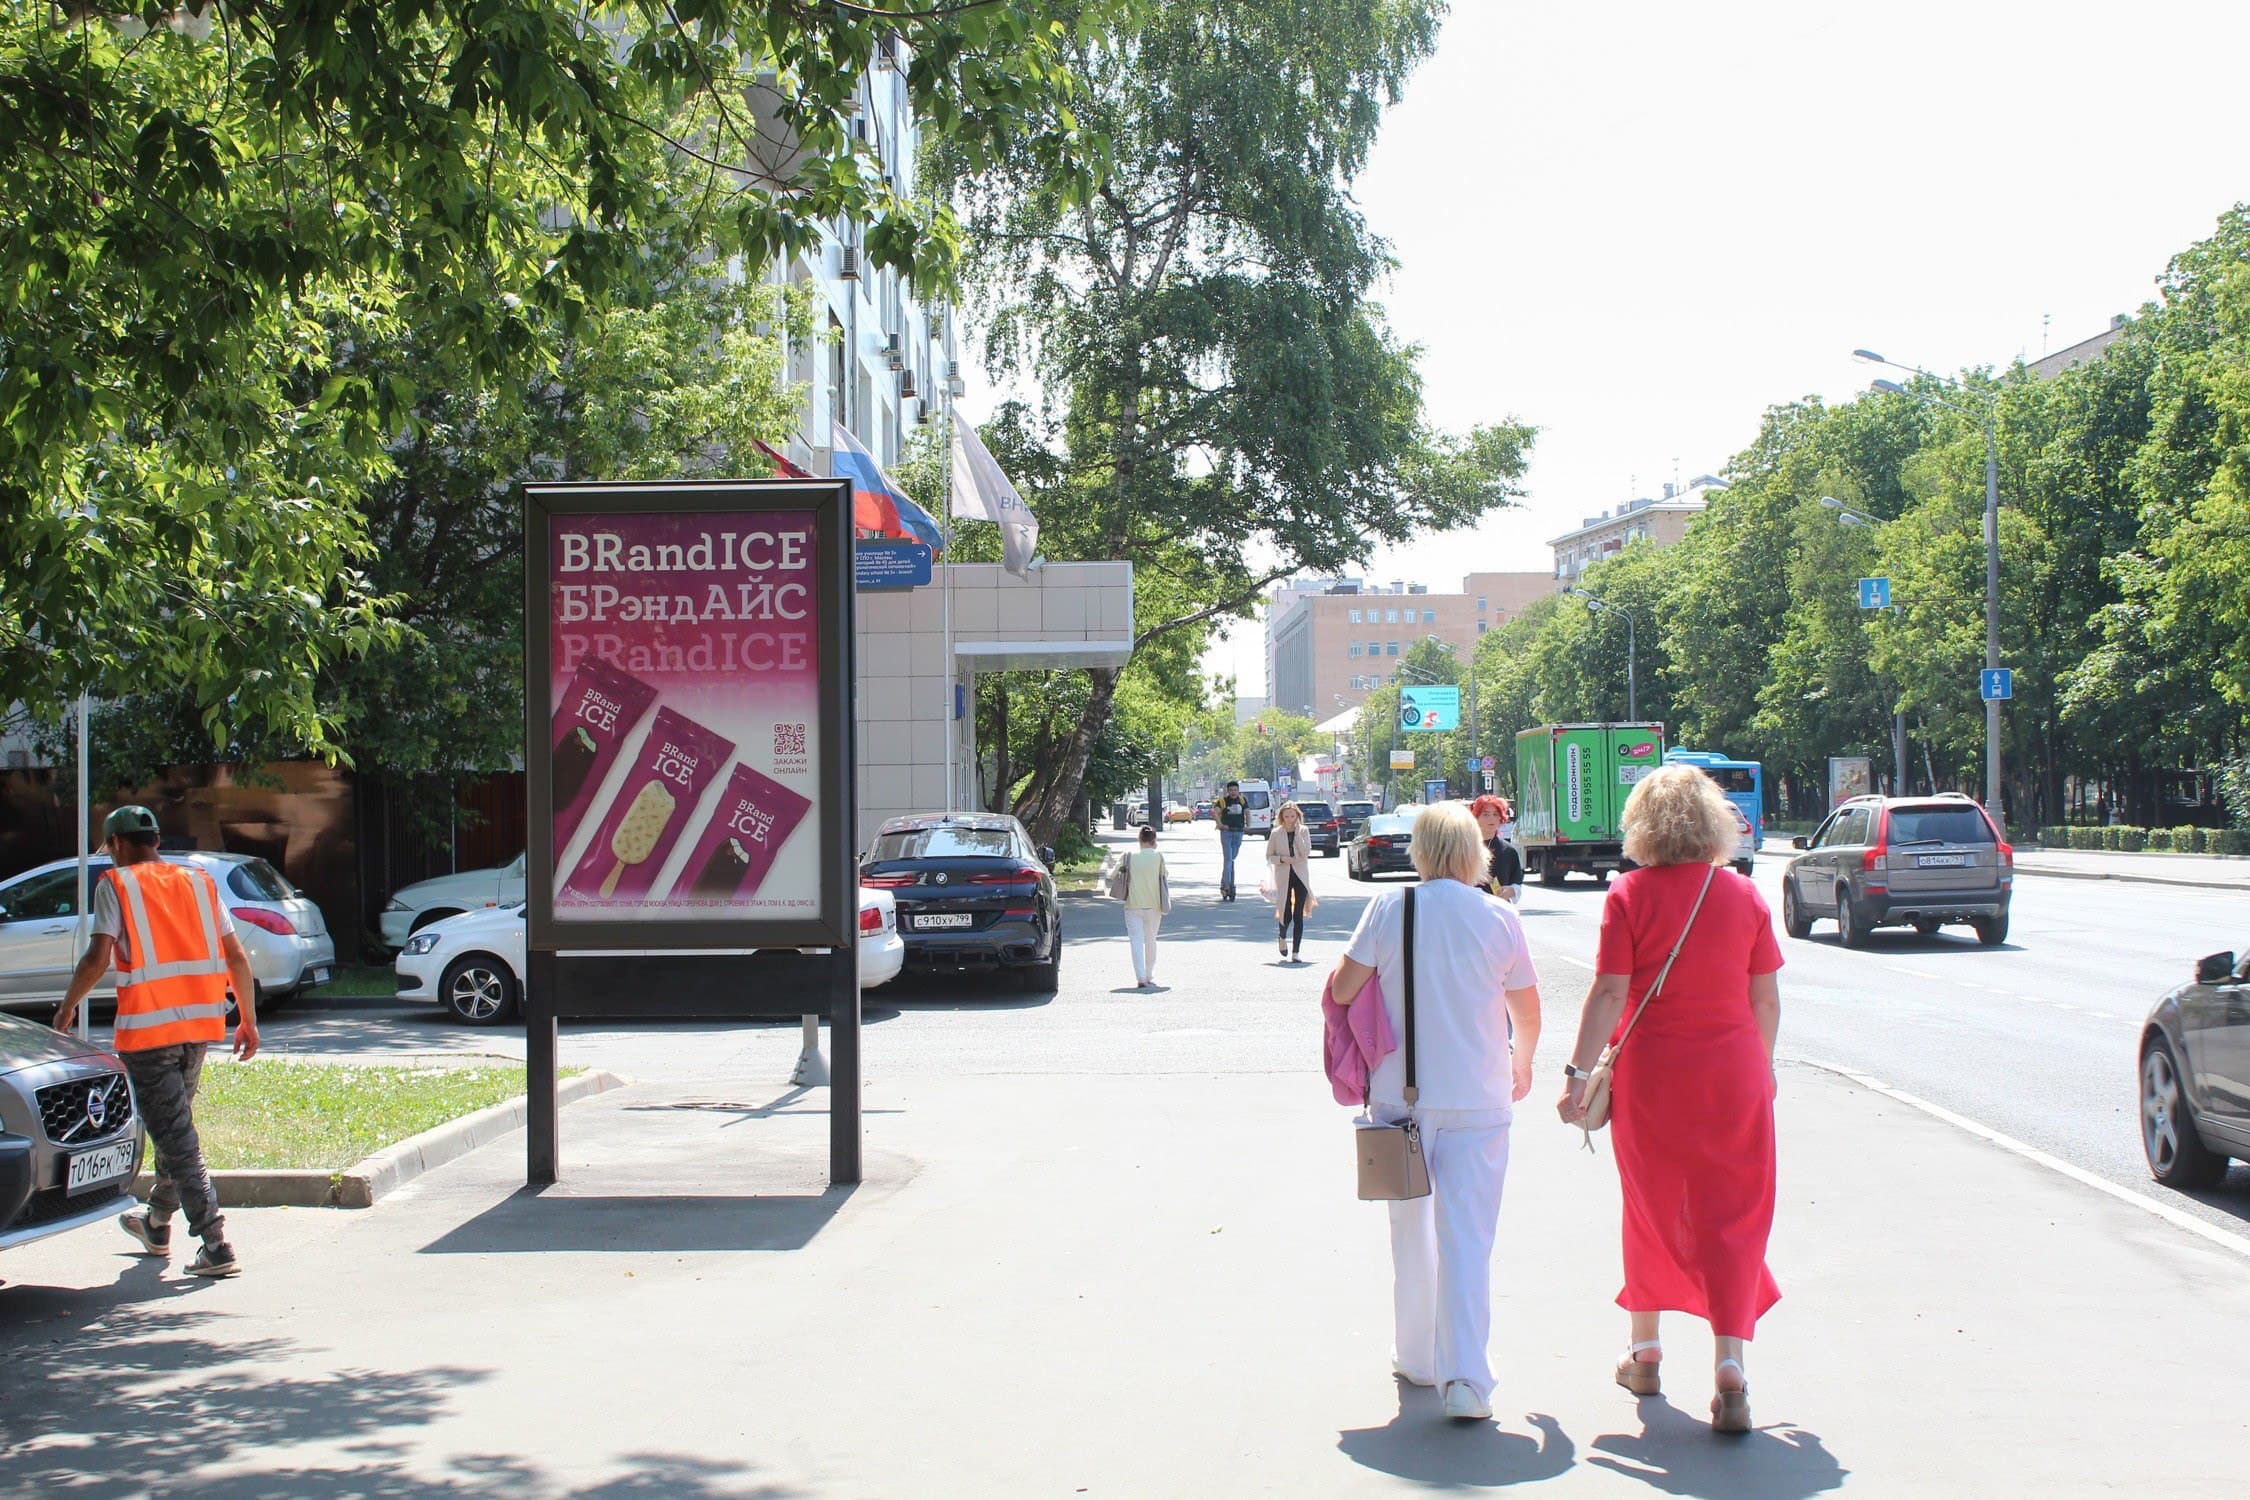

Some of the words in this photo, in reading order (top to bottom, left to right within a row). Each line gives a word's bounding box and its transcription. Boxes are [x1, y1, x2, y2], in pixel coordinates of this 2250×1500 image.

[560, 532, 807, 572] BRandICE
[559, 575, 807, 625] БРэндАЙС
[584, 688, 621, 714] BRand
[575, 699, 616, 731] ICE
[662, 742, 698, 768] BRand
[1583, 747, 1591, 759] 55
[652, 753, 694, 785] ICE
[773, 767, 807, 775] ОНЛАЙН
[1583, 762, 1591, 774] 55
[1584, 776, 1592, 795] 955
[738, 799, 775, 825] BRand
[1584, 797, 1592, 816] 499
[728, 810, 770, 842] ICE
[72, 1153, 113, 1184] Т016РК
[116, 1143, 132, 1165] 799
